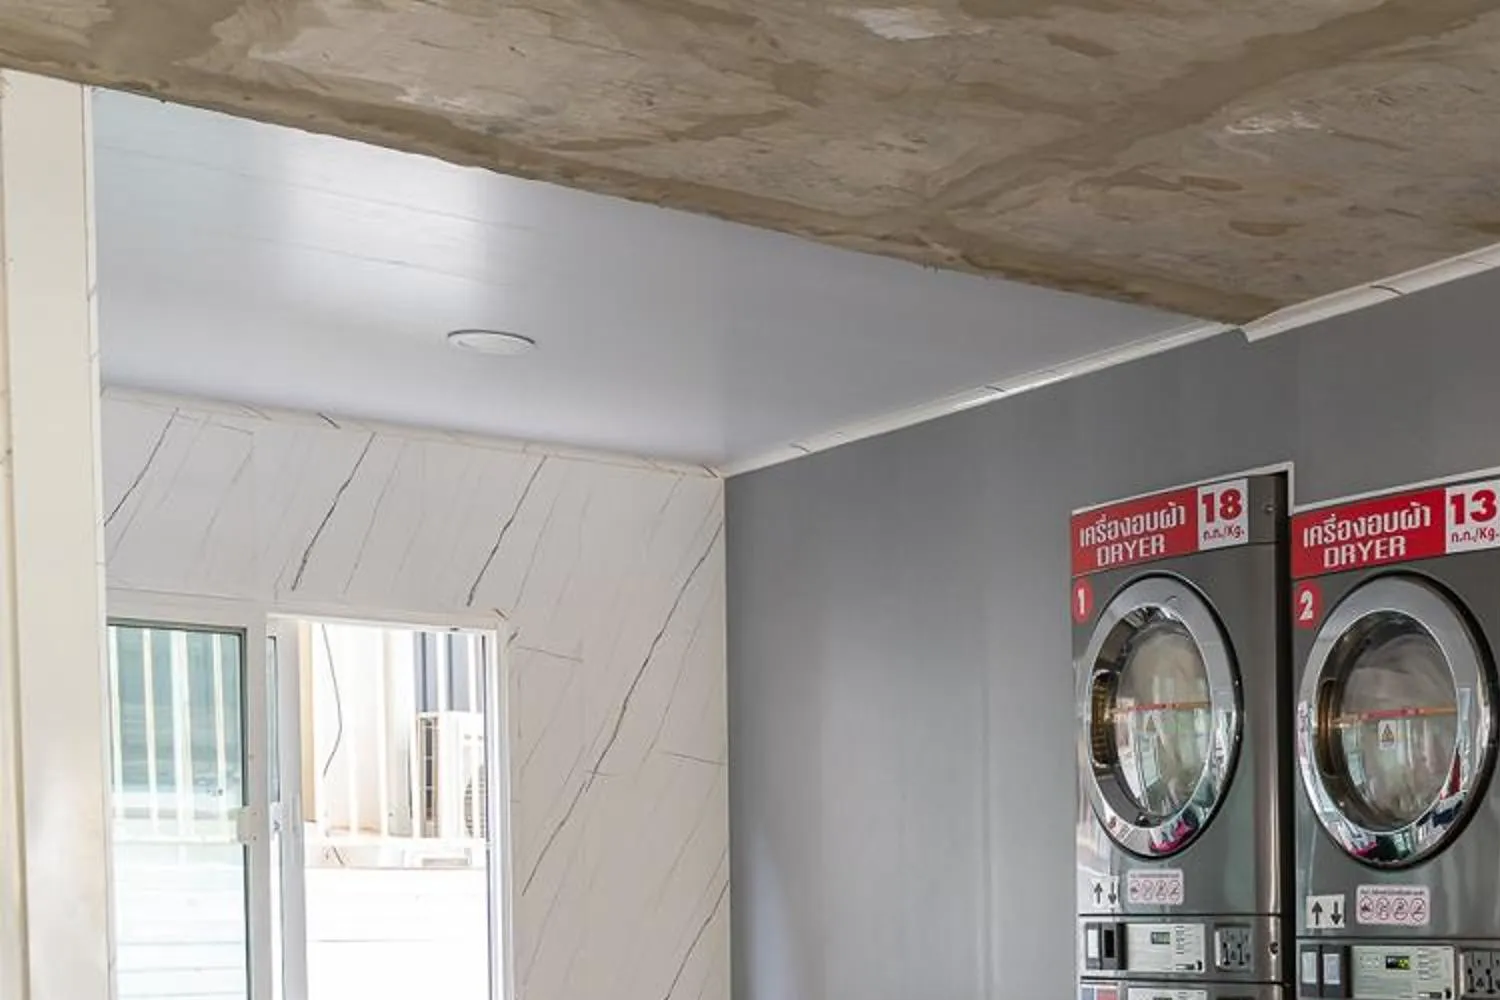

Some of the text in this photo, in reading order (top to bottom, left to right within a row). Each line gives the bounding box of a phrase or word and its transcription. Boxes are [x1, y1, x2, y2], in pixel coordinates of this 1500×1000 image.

[1201, 488, 1242, 523] 18
[1450, 489, 1497, 525] 13
[1303, 501, 1431, 548] เครื่องอบผ้า
[1096, 535, 1165, 568] DRYER
[1323, 535, 1406, 569] DRYER
[1077, 588, 1086, 616] 1
[1299, 590, 1314, 621] 2
